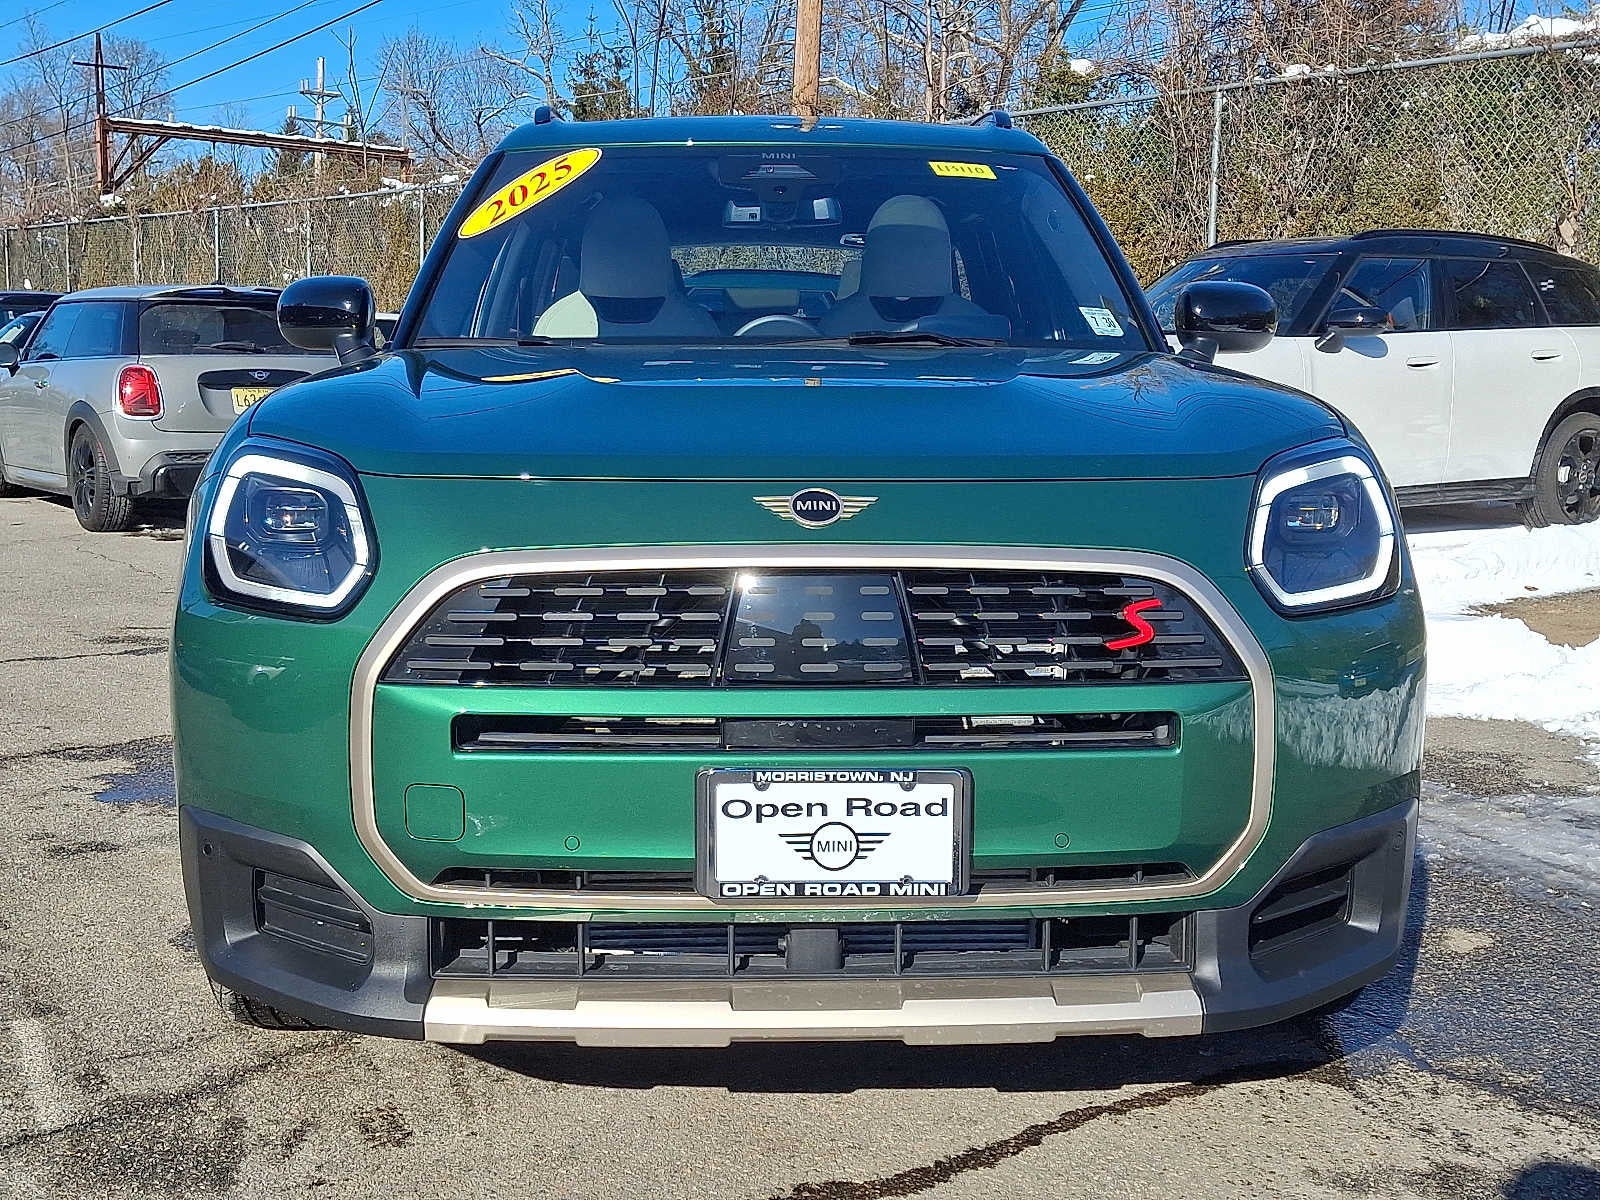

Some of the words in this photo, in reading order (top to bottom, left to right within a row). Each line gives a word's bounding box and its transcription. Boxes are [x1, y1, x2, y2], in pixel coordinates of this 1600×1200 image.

[761, 152, 797, 160] MINI
[486, 157, 573, 225] 2025
[796, 500, 837, 511] MINI
[1103, 597, 1163, 651] S
[755, 771, 884, 783] MORRISTOWN,
[889, 771, 914, 783] NJ
[721, 799, 828, 824] Open
[846, 797, 948, 817] Road
[817, 840, 853, 852] MINI
[722, 883, 800, 896] OPEN
[803, 883, 881, 896] ROAD
[889, 882, 946, 896] MINI
